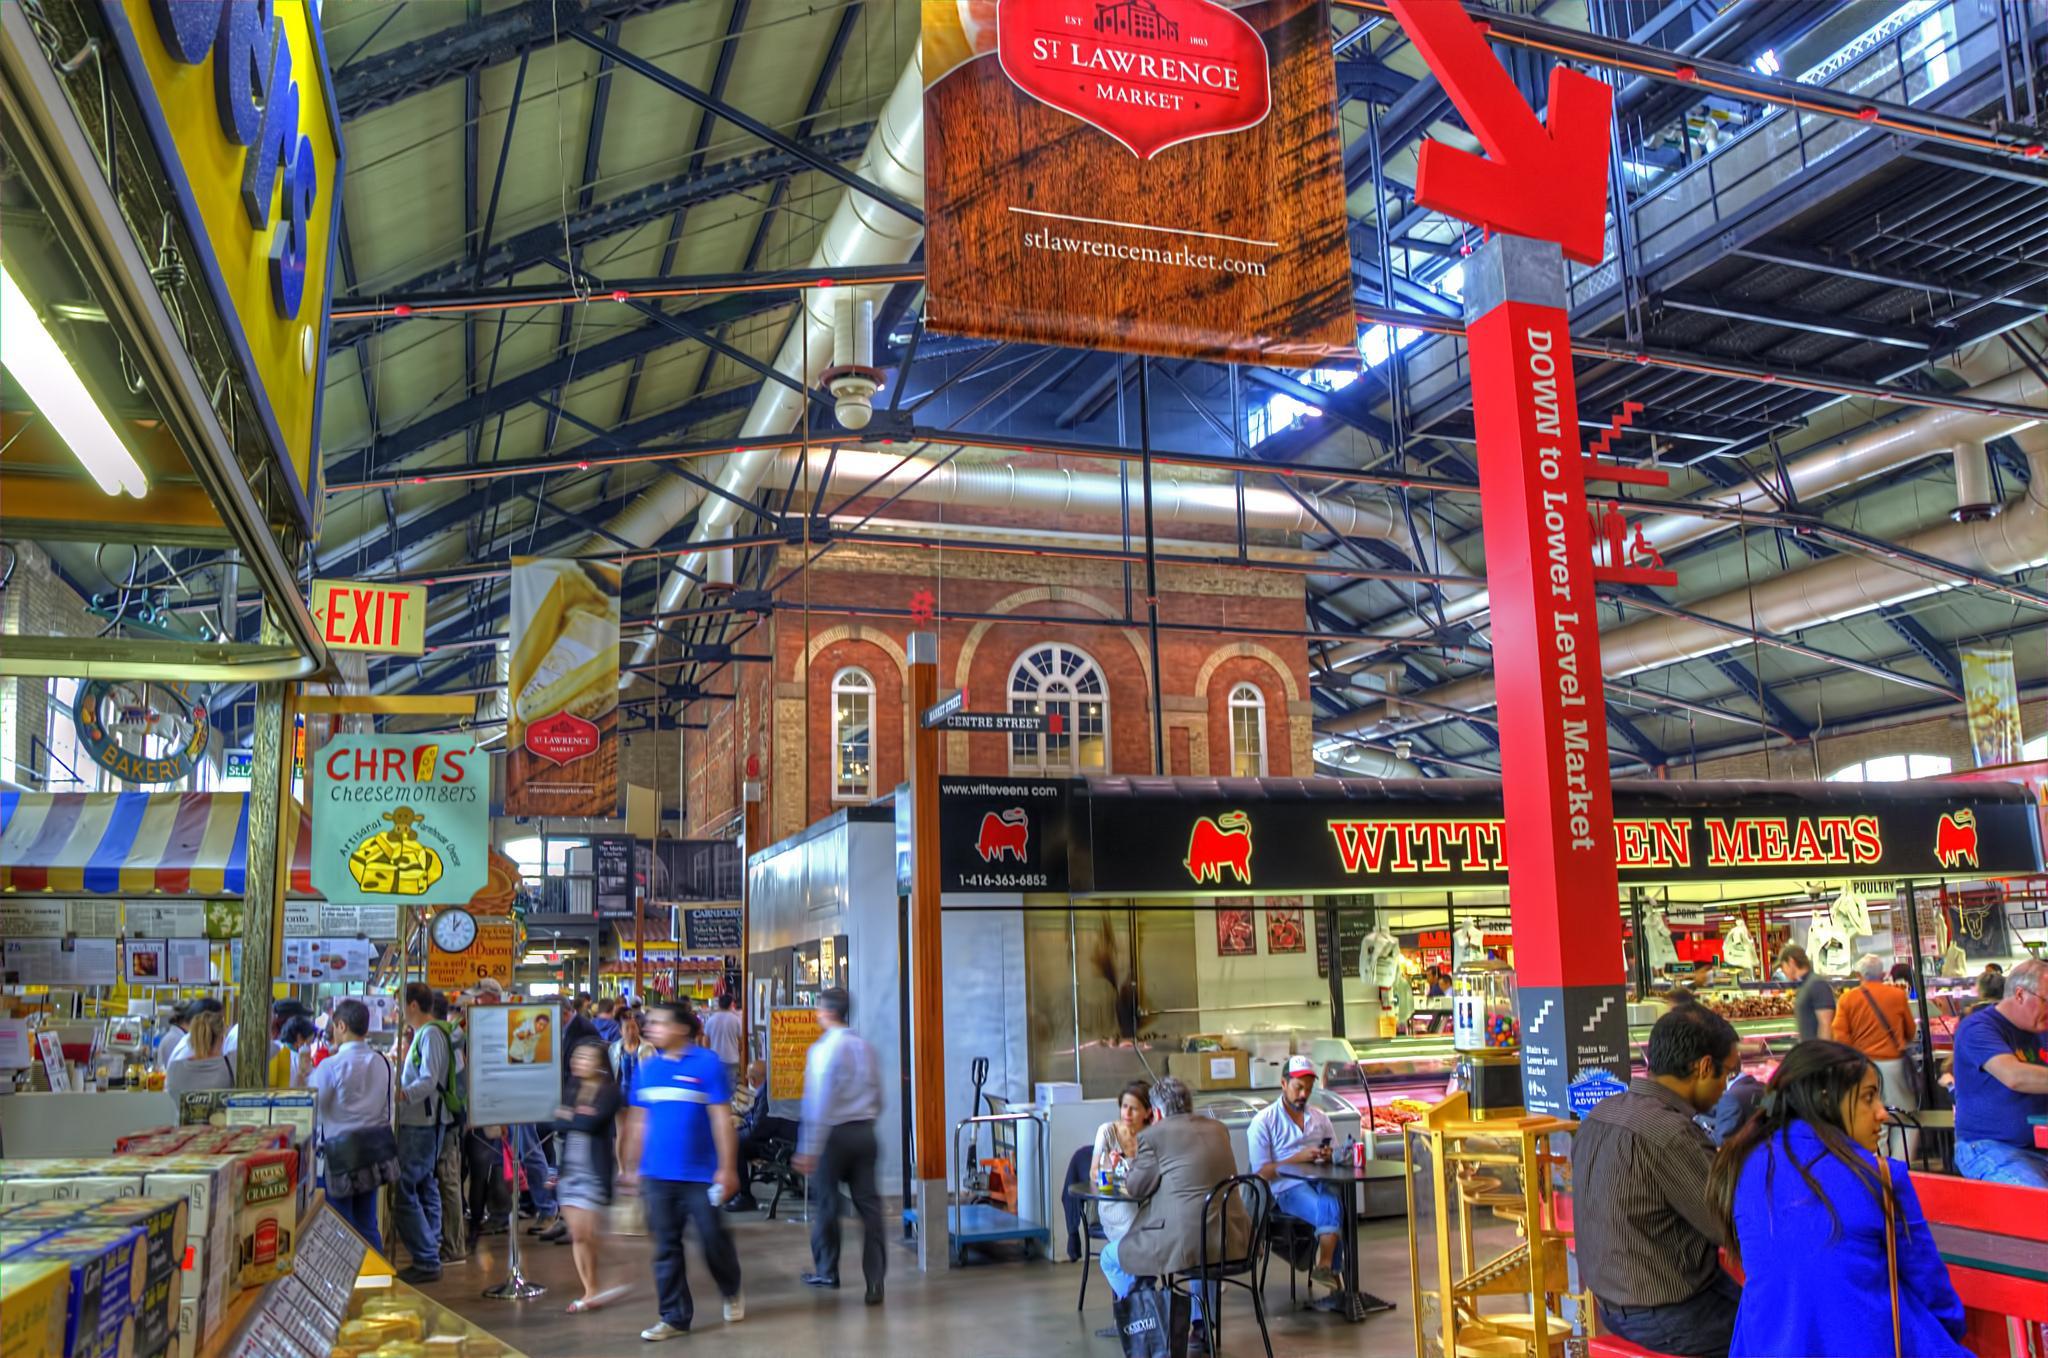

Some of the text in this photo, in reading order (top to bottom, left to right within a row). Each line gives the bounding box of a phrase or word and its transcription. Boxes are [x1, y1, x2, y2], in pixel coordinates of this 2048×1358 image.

[1064, 14, 1083, 26] EST
[1070, 42, 1241, 92] LAWRENCE
[1096, 83, 1185, 111] MARKET
[1023, 227, 1268, 278] stlawrencemarket.com
[1526, 327, 1596, 851] DOWN to Lower Level Market
[325, 587, 410, 647] EXIT
[928, 693, 962, 722] MARKET STREET
[946, 716, 1041, 729] CENTRE STREET
[543, 735, 591, 745] LAWRENCE
[550, 745, 575, 753] MARKET
[100, 744, 182, 783] BAKERY
[330, 785, 478, 802] Cheesemongers
[338, 818, 383, 858] Artisanal
[1704, 814, 1883, 867] MEATS
[959, 873, 1048, 888] 1-416-363-6852
[1853, 880, 1895, 895] POULTRY
[1676, 908, 1697, 919] PORK
[1488, 922, 1507, 931] BEEF
[1526, 1045, 1550, 1055] Stairs to:
[1577, 1045, 1609, 1055] Stairs to:
[1526, 1055, 1558, 1066] Lower Level
[1578, 1053, 1620, 1066] Lower Level
[1527, 1066, 1546, 1076] Market
[246, 1183, 288, 1201] CRACKERS
